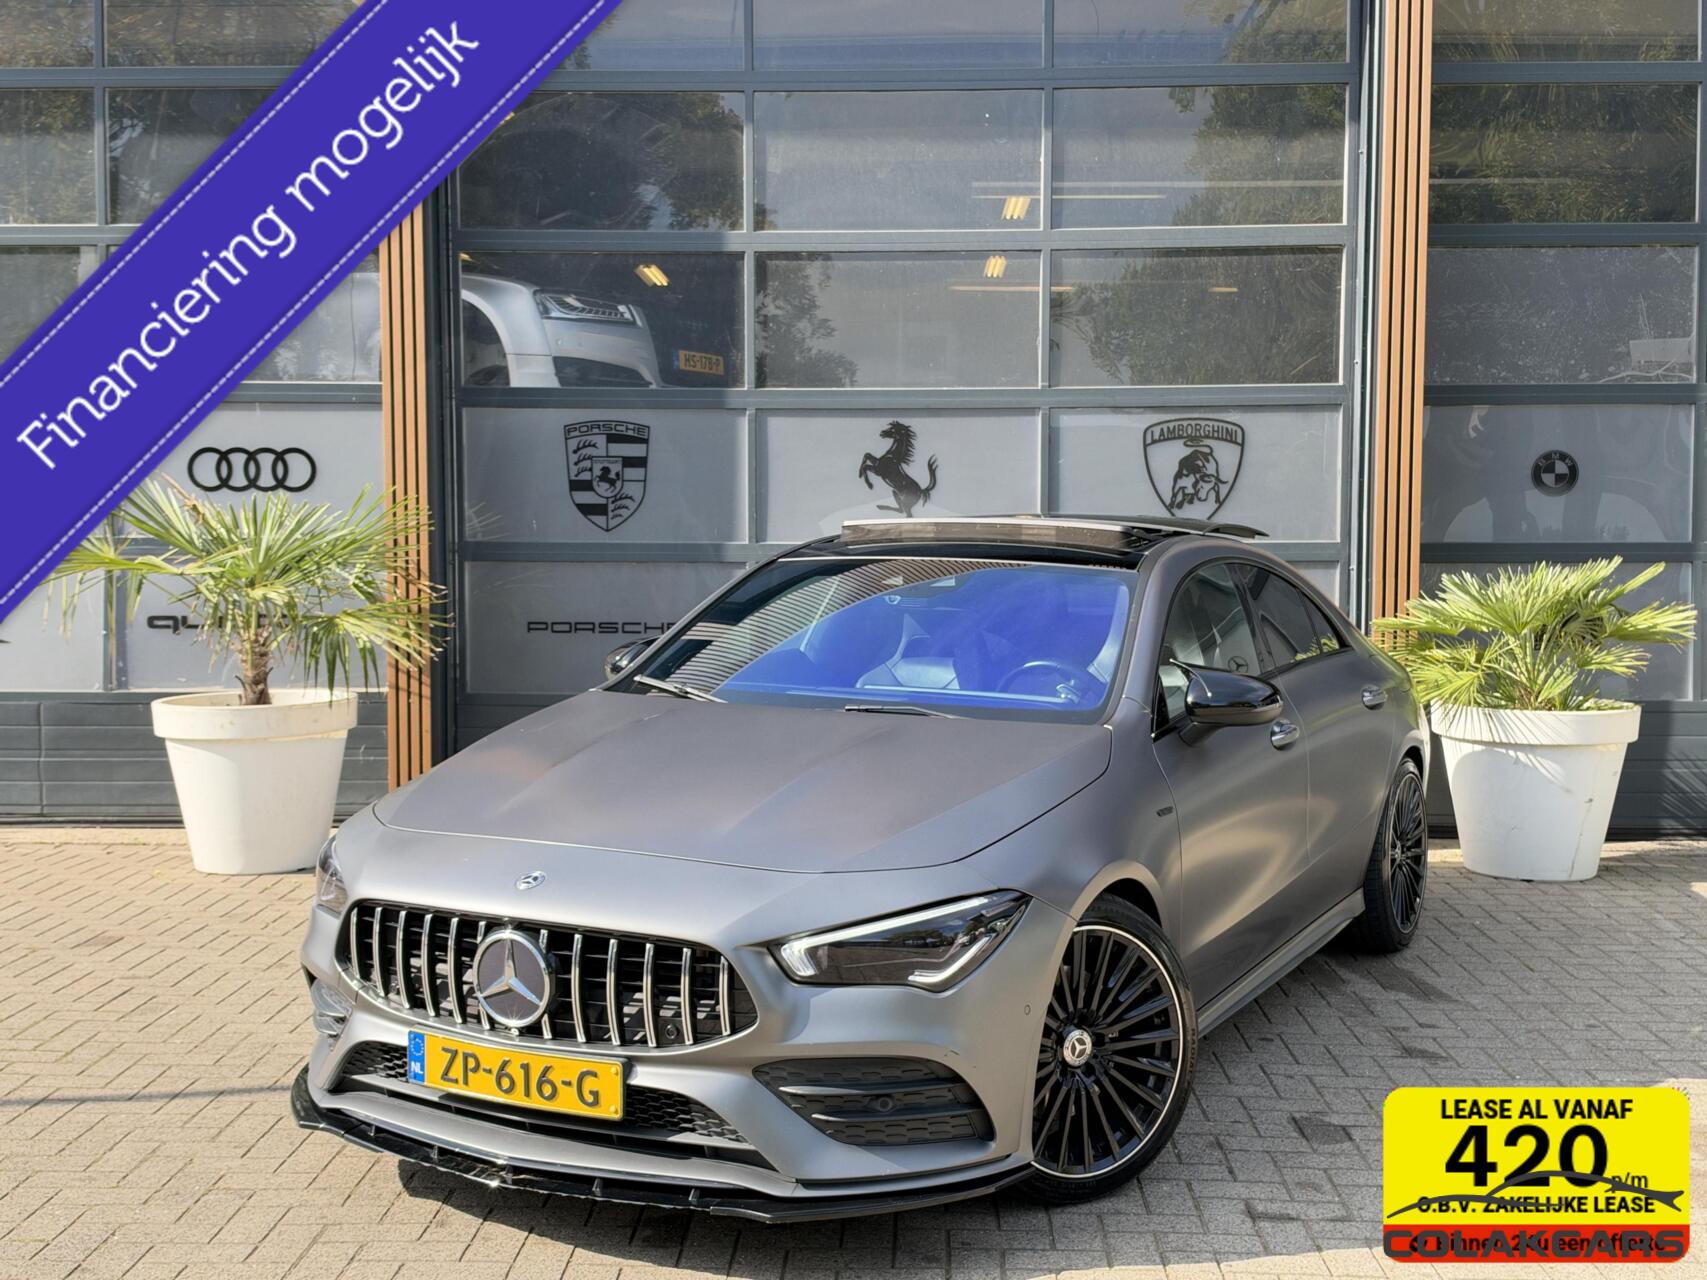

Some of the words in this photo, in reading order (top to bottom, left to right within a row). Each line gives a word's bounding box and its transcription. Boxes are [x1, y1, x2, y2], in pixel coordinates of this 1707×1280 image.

[566, 423, 647, 436] PORSCHE
[1150, 423, 1239, 442] LAMBORGHINI
[410, 1060, 424, 1075] NL
[440, 1046, 600, 1108] ZP-616-G
